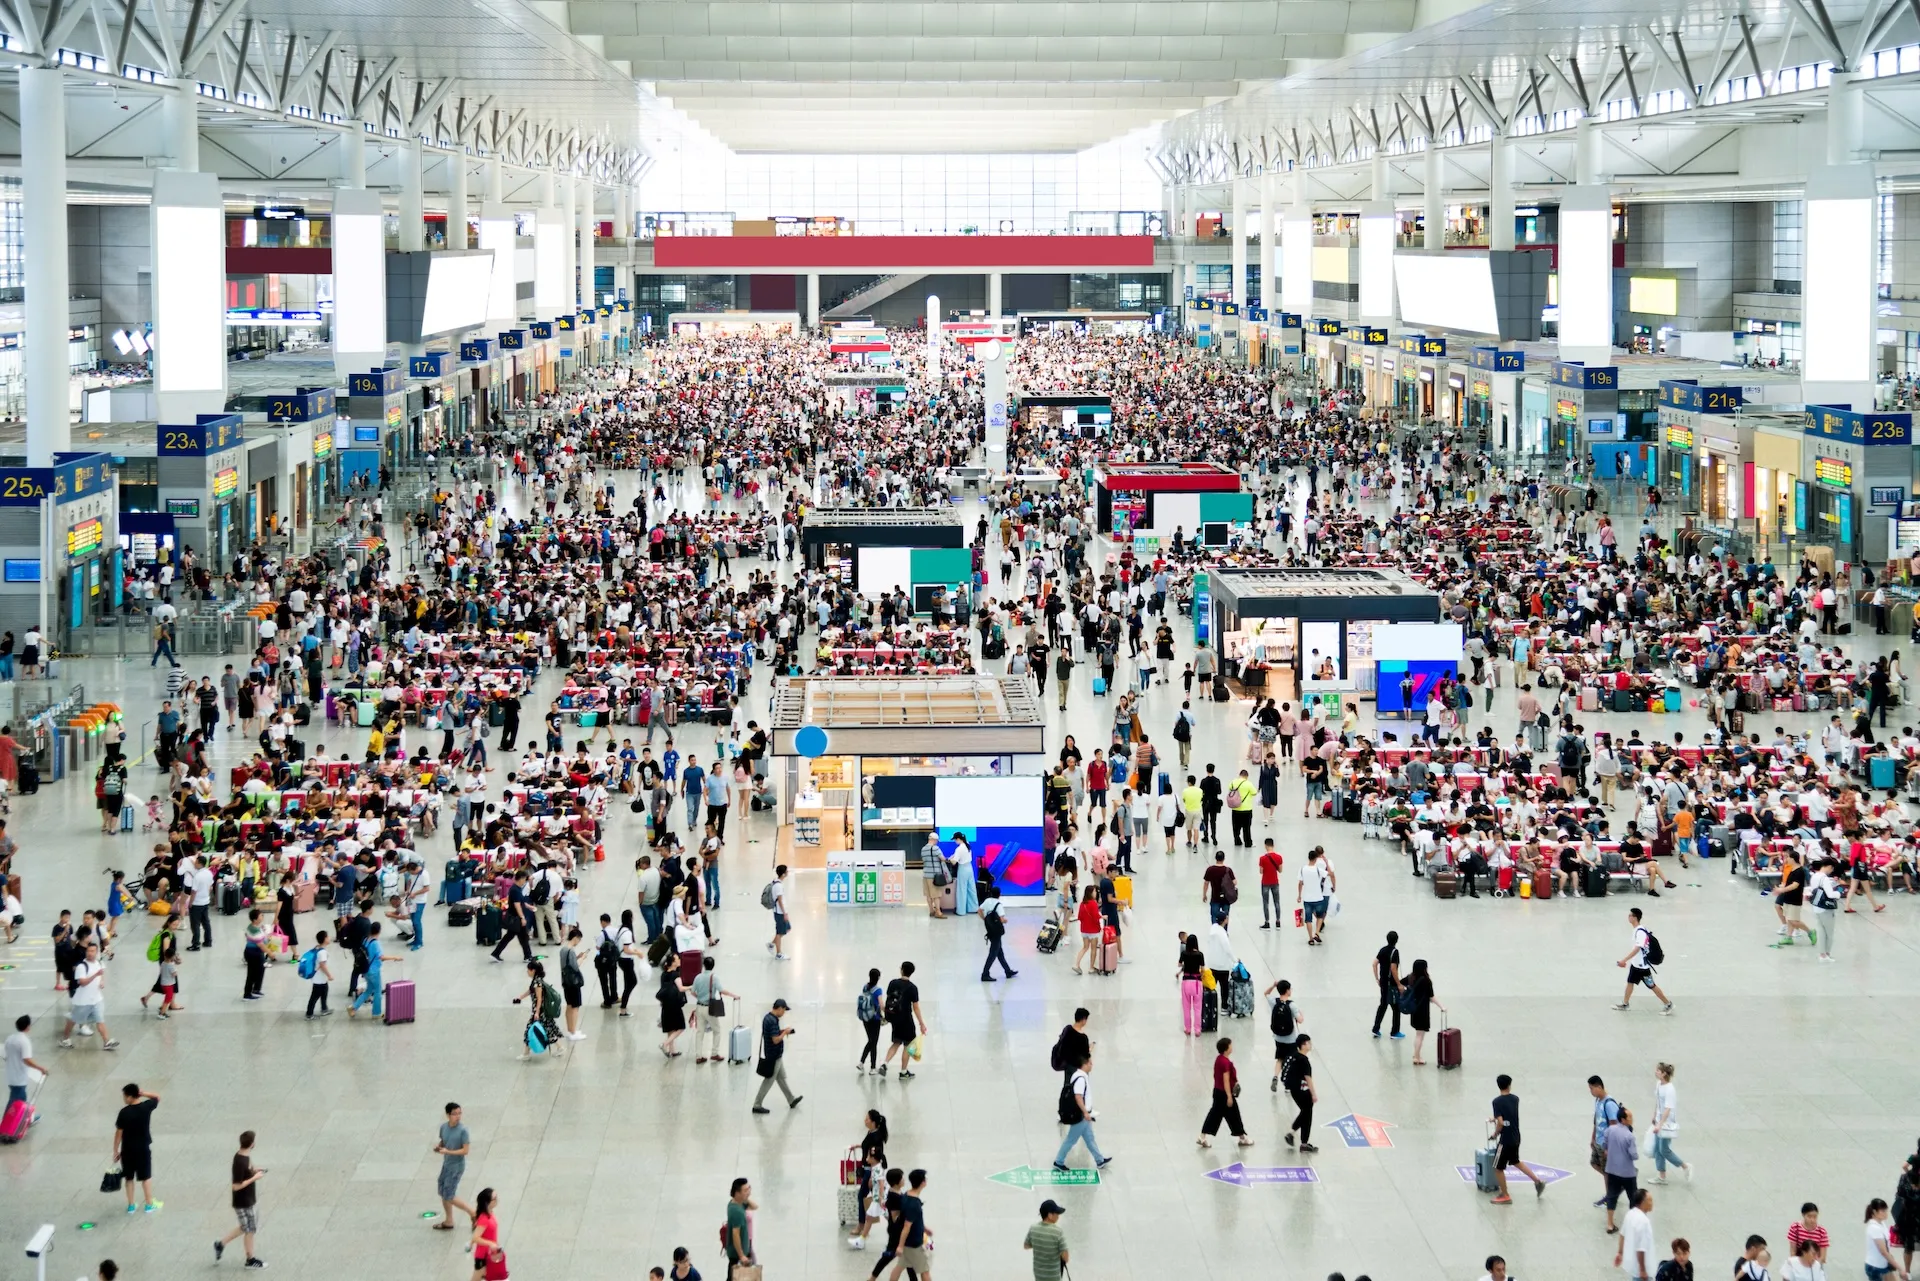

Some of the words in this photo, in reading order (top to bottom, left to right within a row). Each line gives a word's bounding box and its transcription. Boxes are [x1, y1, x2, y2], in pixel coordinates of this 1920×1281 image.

[533, 328, 548, 336] 11A
[1323, 324, 1338, 333] 11B
[502, 336, 518, 345] 13A
[1368, 332, 1384, 342] 13B
[464, 347, 482, 357] 15A
[1424, 342, 1442, 352] 15B
[414, 361, 436, 372] 17A
[1500, 356, 1520, 367] 17B
[1590, 372, 1612, 384] 19B
[354, 379, 378, 392] 19A
[1708, 393, 1736, 408] 21B
[273, 402, 302, 416] 21A
[1872, 422, 1904, 438] 23B
[165, 432, 198, 449] 23A
[4, 477, 45, 498] 25A
